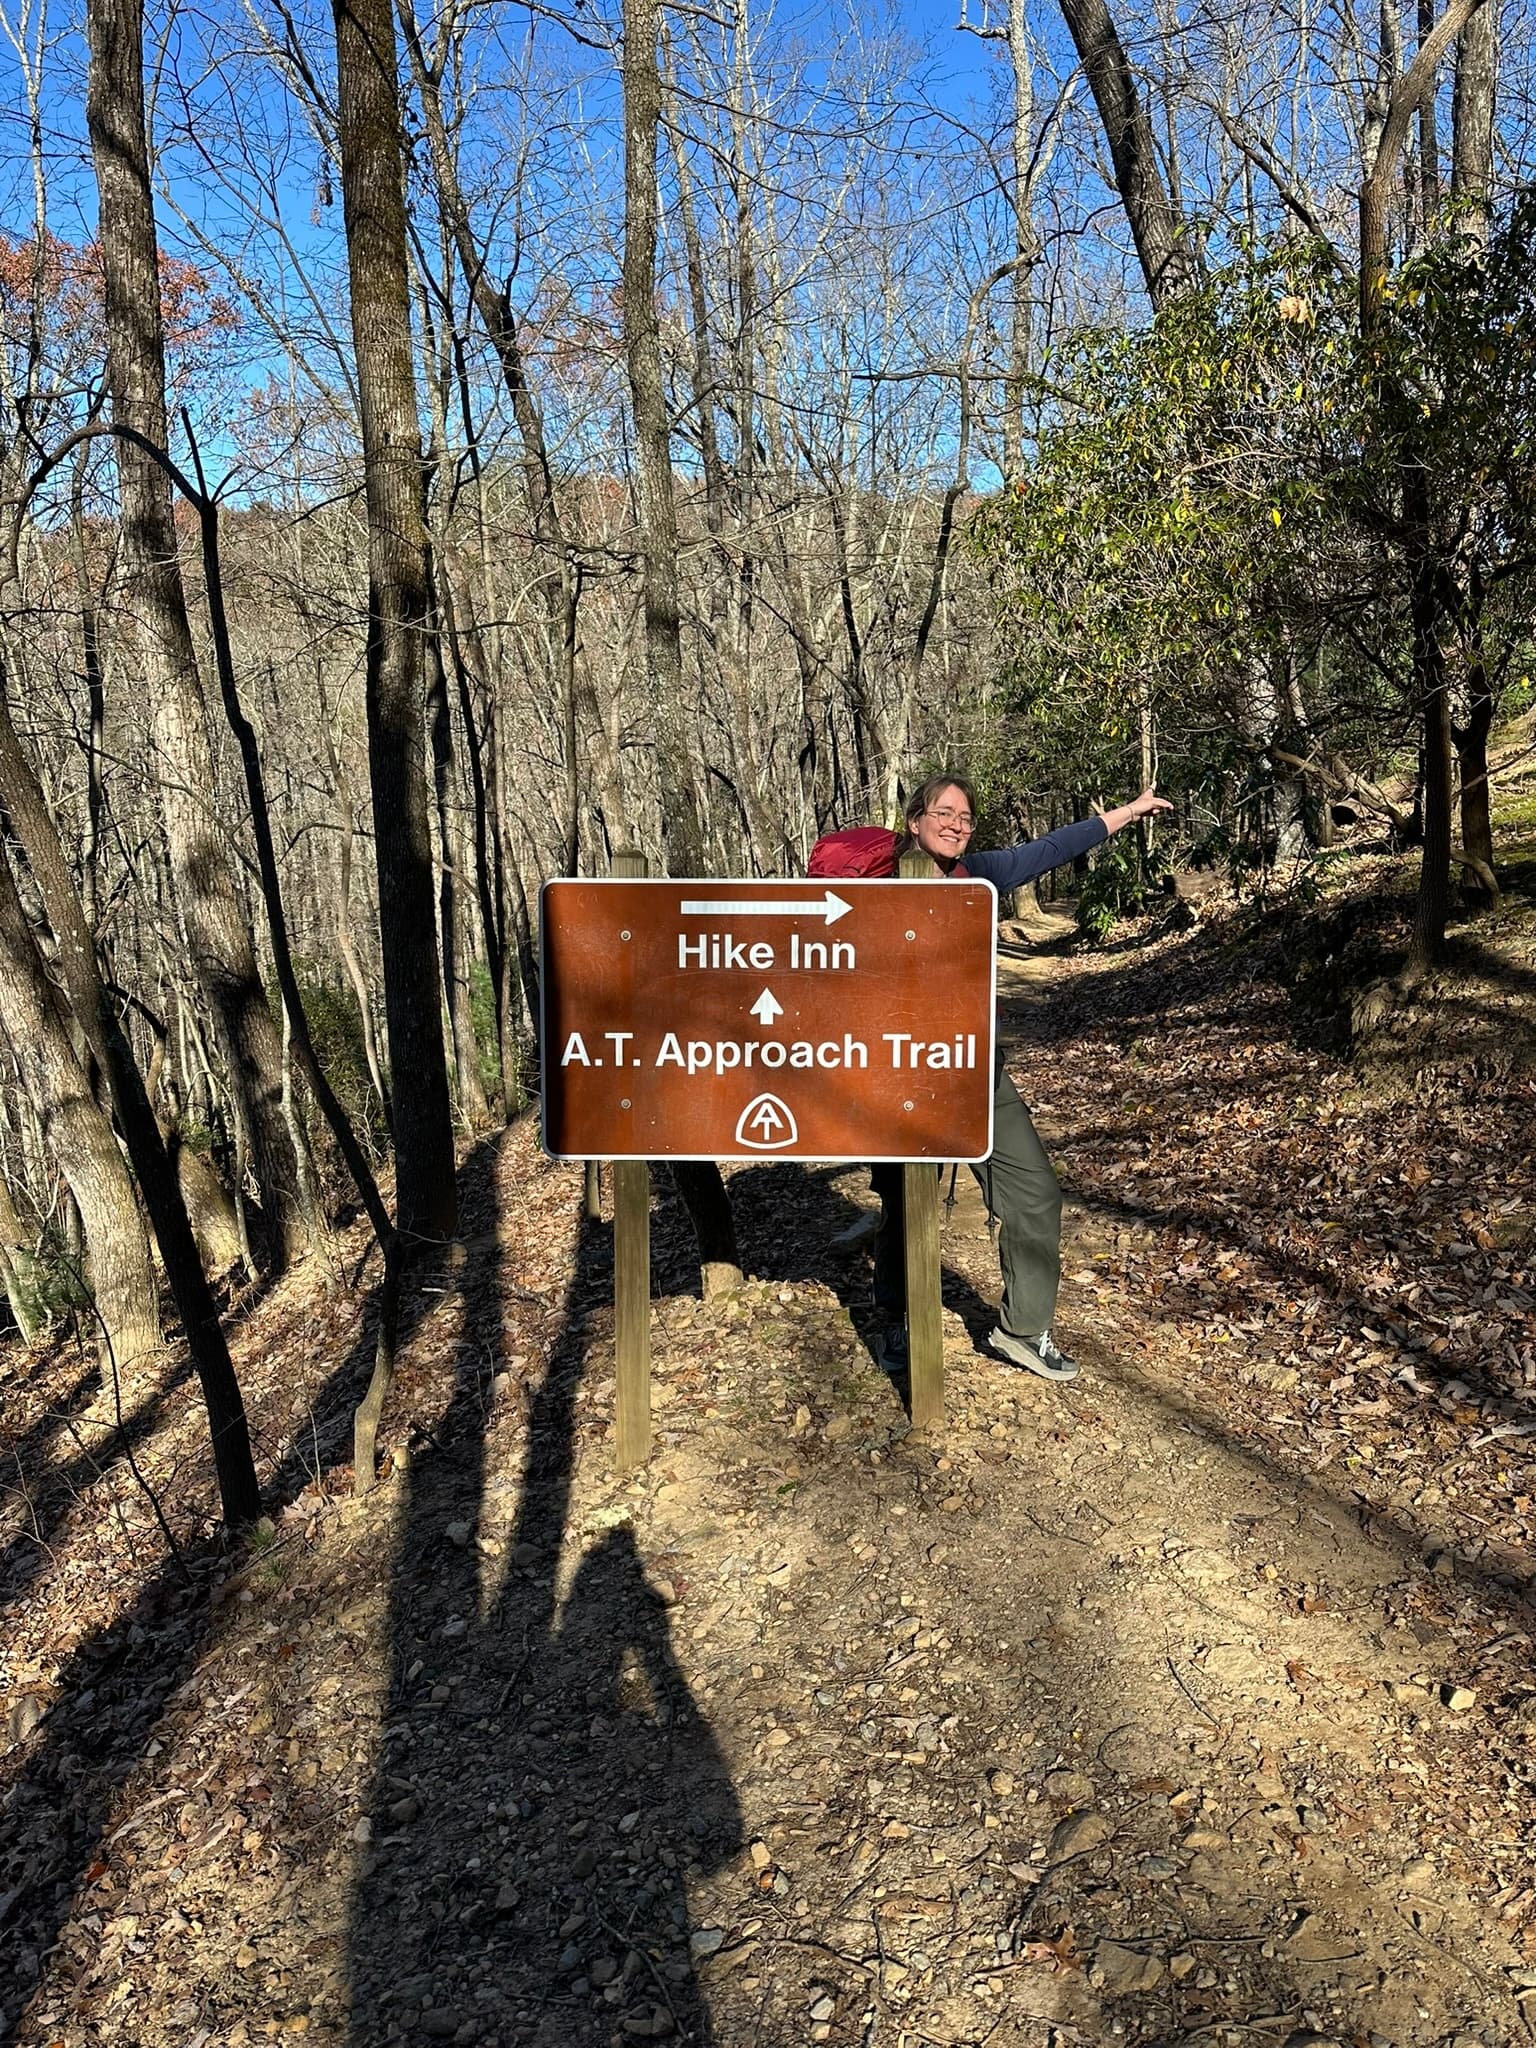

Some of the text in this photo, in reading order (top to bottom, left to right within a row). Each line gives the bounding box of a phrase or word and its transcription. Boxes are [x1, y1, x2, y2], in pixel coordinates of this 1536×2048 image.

[678, 933, 856, 969] Hike Inn
[561, 1032, 976, 1075] A.T. Approach Trail
